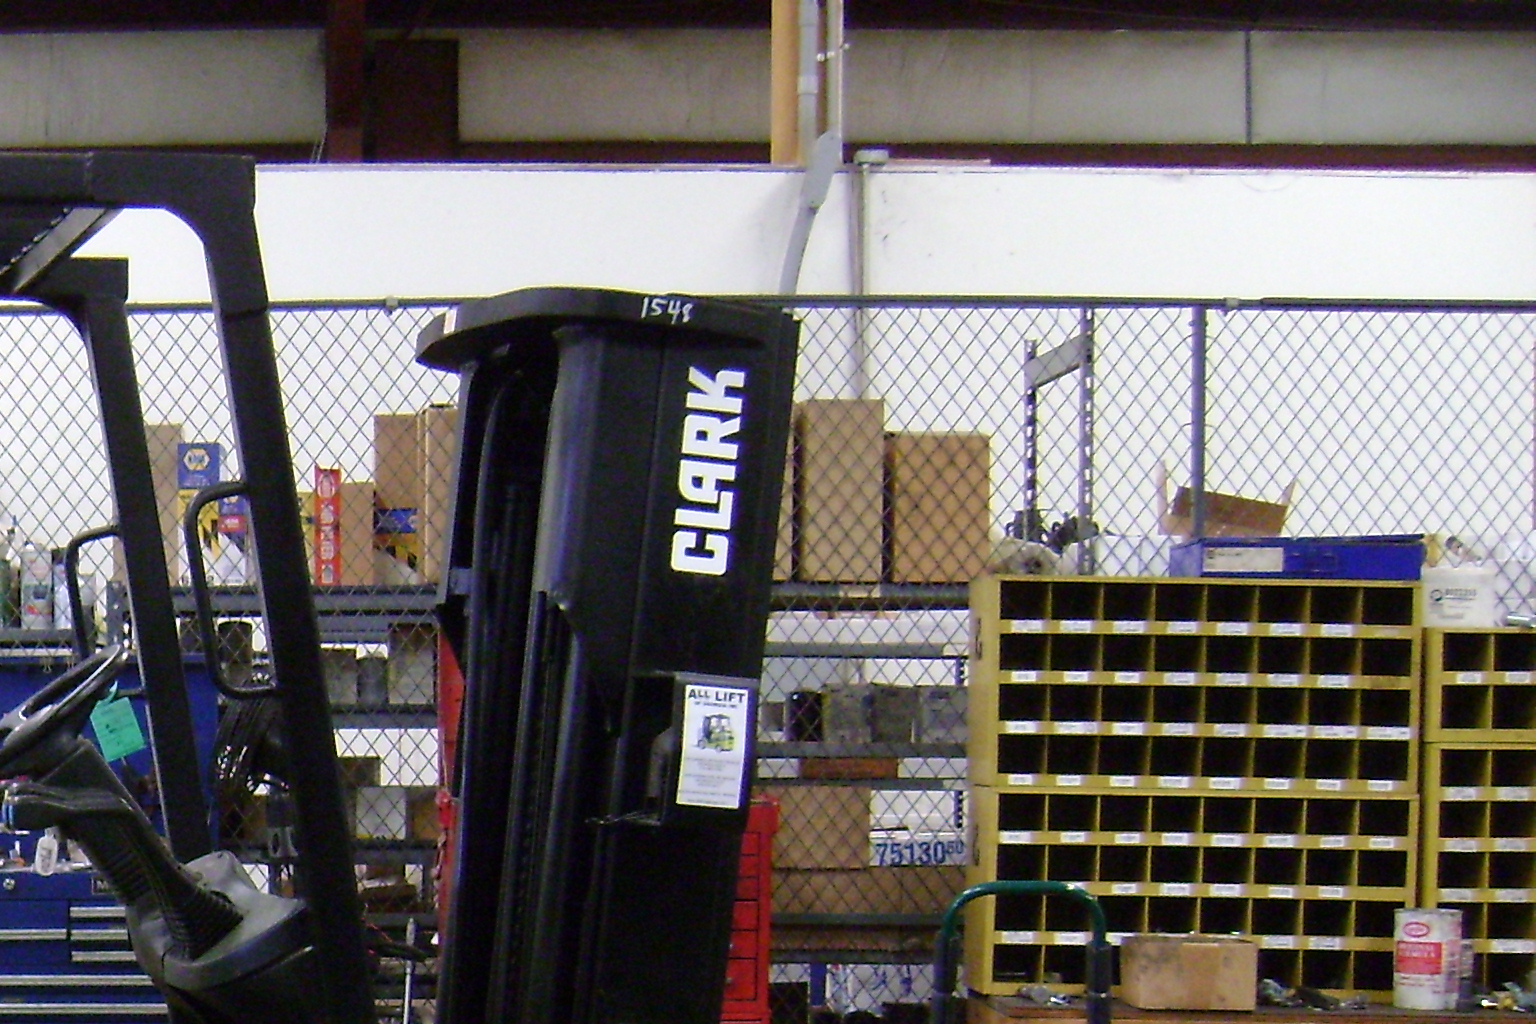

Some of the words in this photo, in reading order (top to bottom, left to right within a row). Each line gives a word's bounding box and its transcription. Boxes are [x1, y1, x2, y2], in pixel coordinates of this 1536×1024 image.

[641, 297, 694, 325] 1548
[670, 366, 745, 576] CLARK
[689, 689, 710, 699] ALL
[716, 692, 745, 703] LIFT
